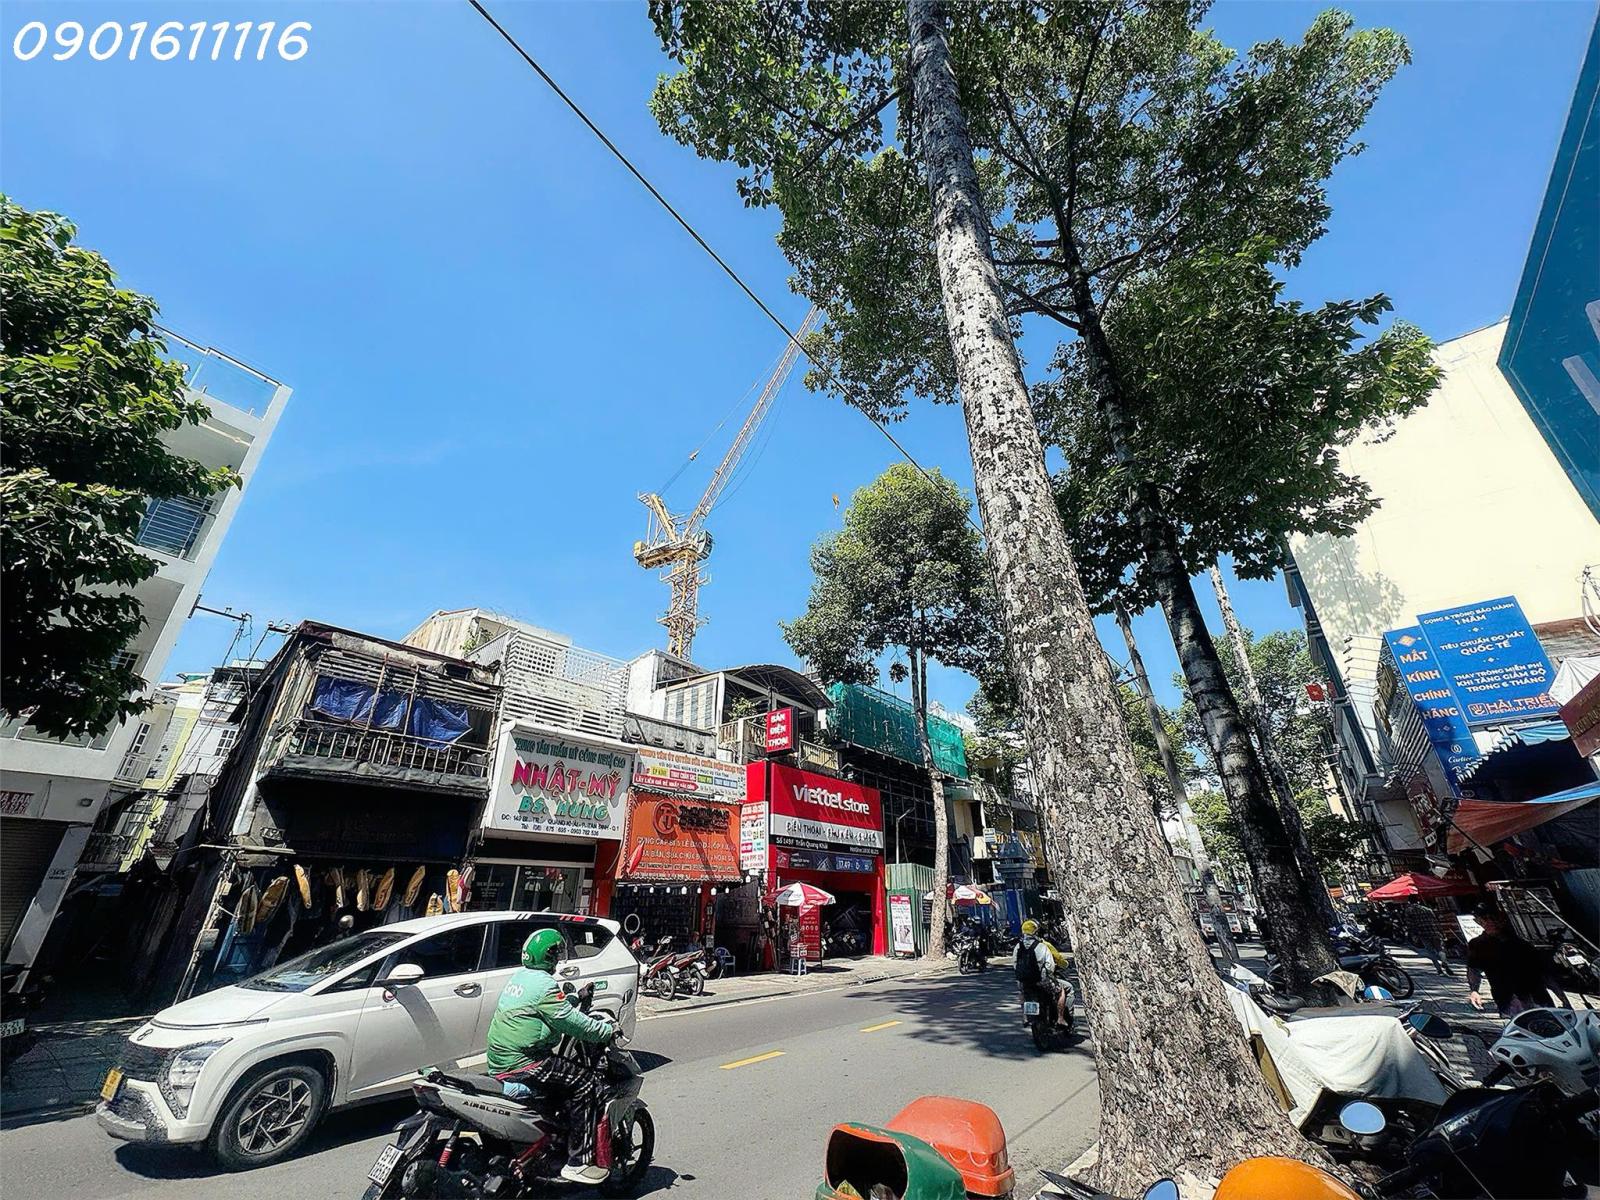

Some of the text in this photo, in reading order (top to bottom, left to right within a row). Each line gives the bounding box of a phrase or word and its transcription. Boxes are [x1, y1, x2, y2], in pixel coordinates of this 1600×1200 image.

[1462, 612, 1487, 624] NĂM
[1440, 641, 1459, 651] TIÊU
[1491, 634, 1505, 642] ĐO
[1460, 639, 1512, 657] QUỐC TẾ
[1400, 648, 1428, 664] MẮT
[1406, 669, 1441, 683] KÍNH
[1454, 672, 1475, 681] THAY
[1476, 668, 1504, 677] TRÒNG
[1528, 660, 1544, 669] PHÍ
[1457, 666, 1547, 688] KHI TĂNG GIẢM ĐỘ
[1467, 682, 1501, 693] TRONG
[1510, 675, 1547, 687] THÁNG
[1414, 688, 1452, 702] CHÍNH
[1486, 698, 1513, 712] HẢI
[771, 712, 786, 723] BÁN
[1422, 707, 1459, 720] HÃNG
[462, 1101, 511, 1117] AIRBLADE
